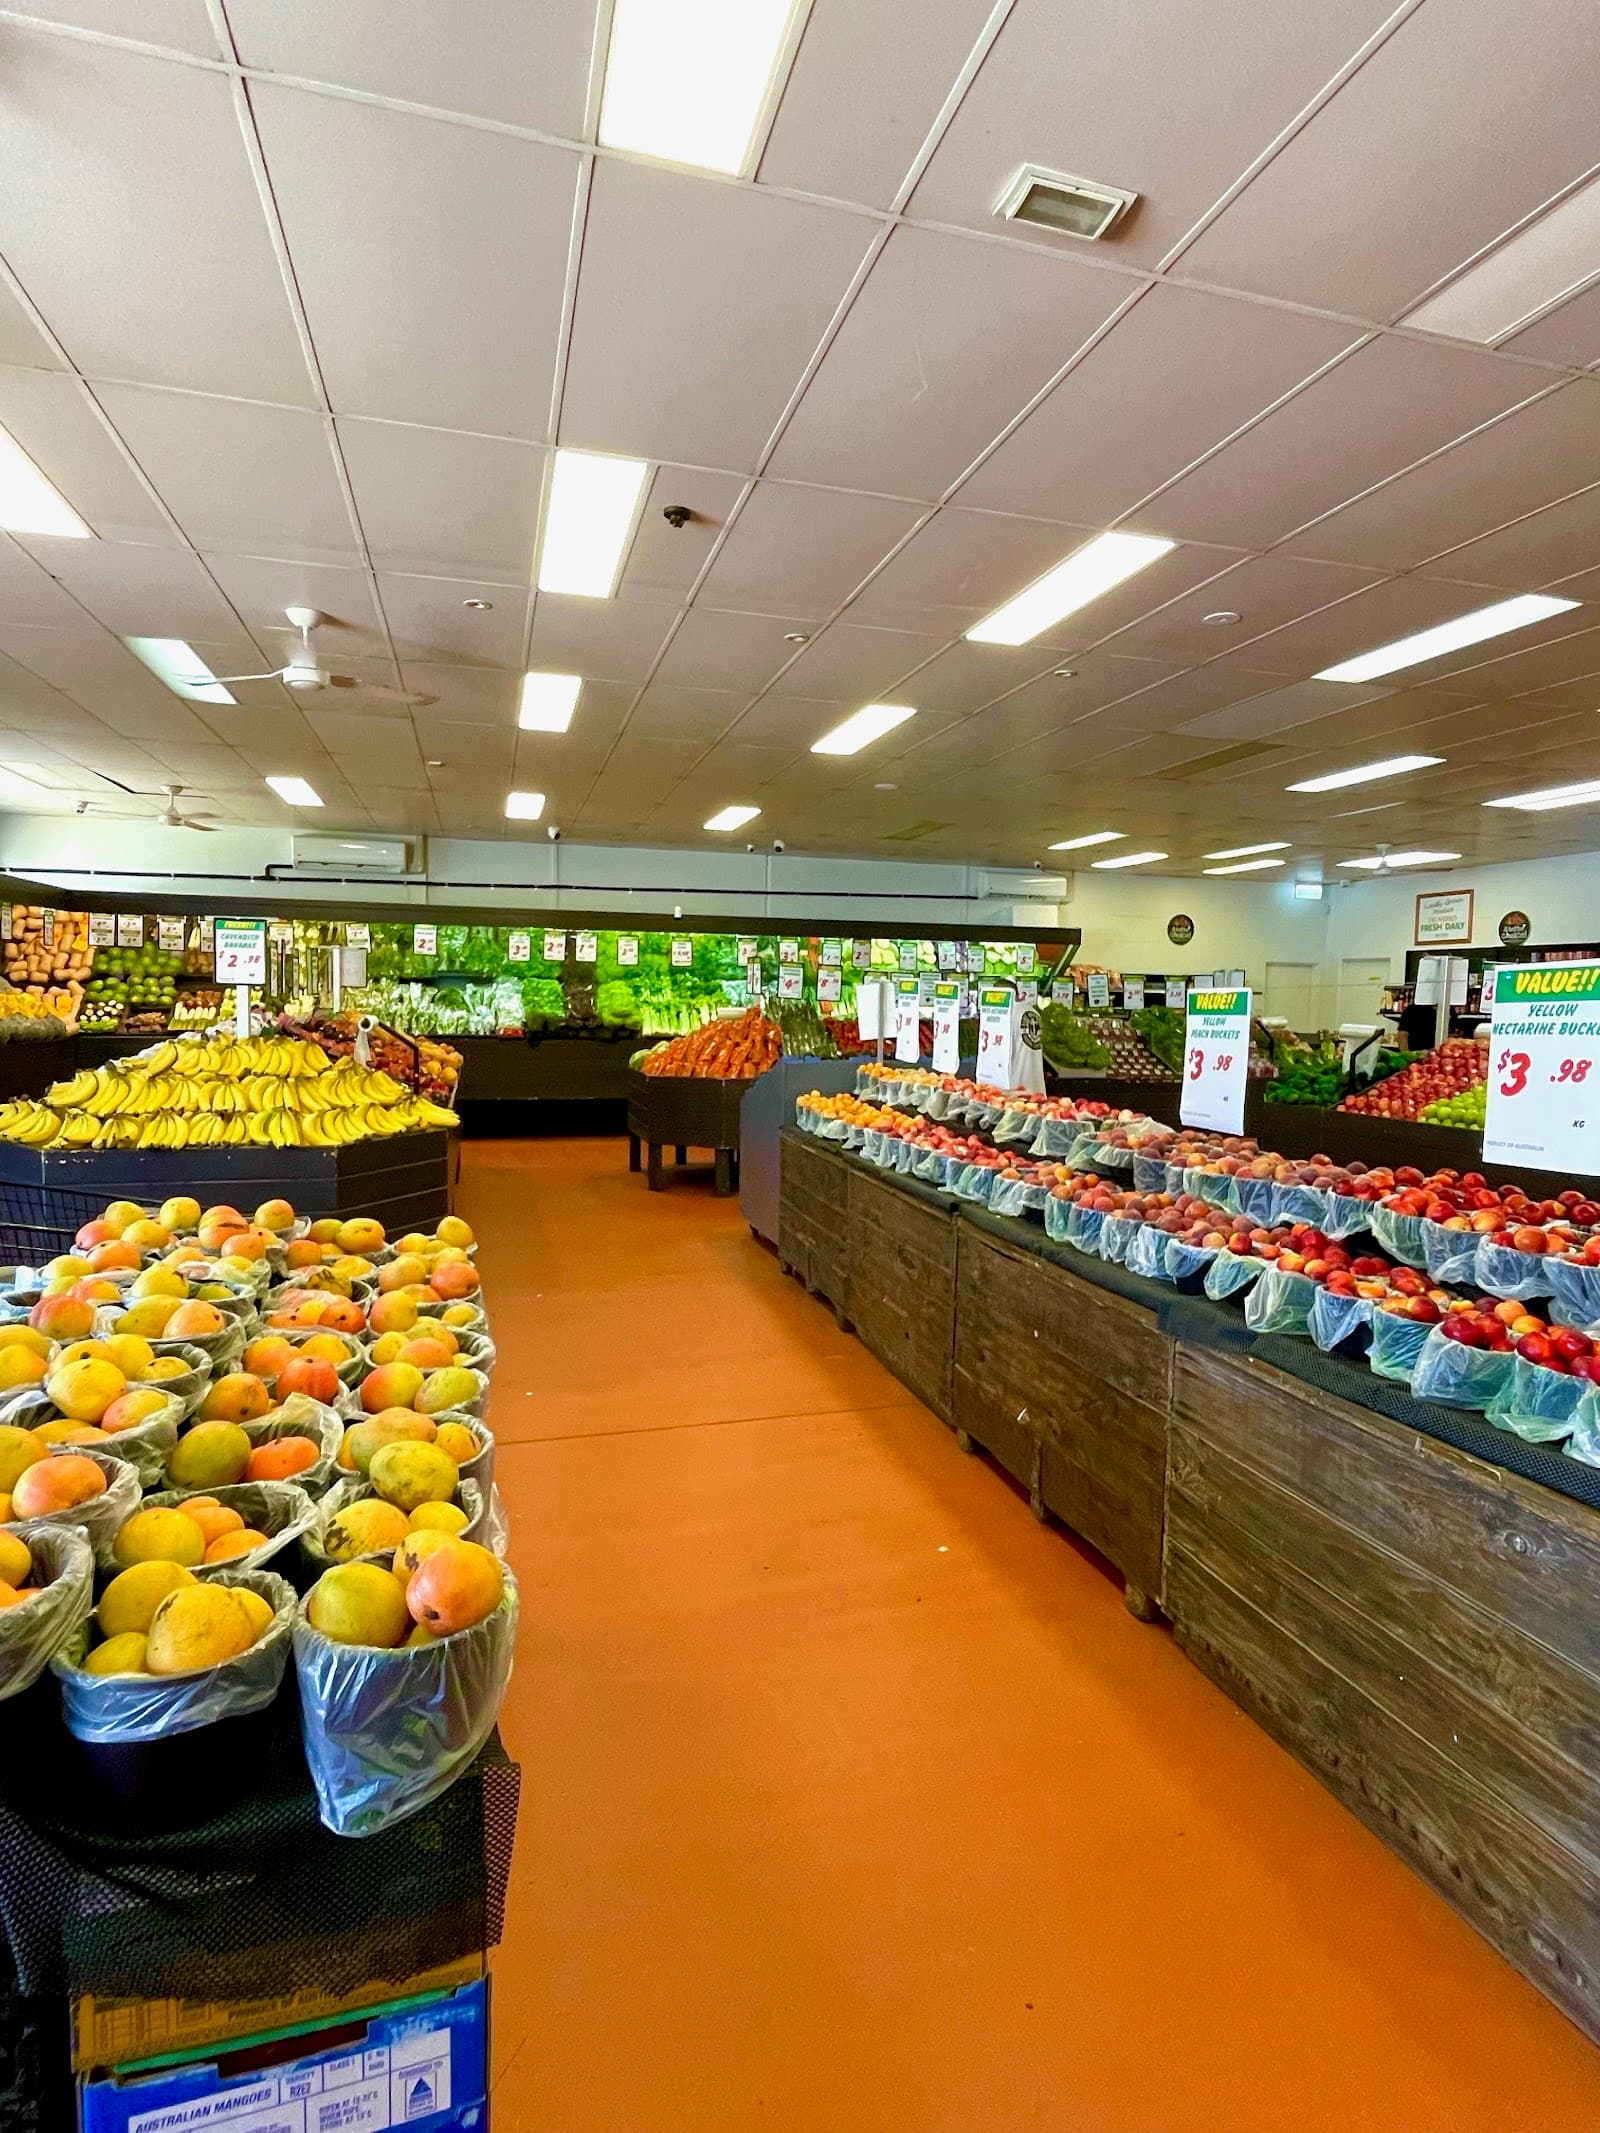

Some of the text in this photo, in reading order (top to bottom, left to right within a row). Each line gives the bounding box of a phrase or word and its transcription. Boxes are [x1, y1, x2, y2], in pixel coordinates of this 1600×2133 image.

[1421, 922, 1465, 932] FRESH DAILY
[1516, 968, 1600, 994] VALUE!!
[1195, 993, 1237, 1010] VALUE!!
[1528, 1003, 1579, 1017] YELLOW
[1202, 1017, 1227, 1026] YELLOW
[1492, 1022, 1556, 1035] NECTARINE
[1191, 1029, 1240, 1040] PEACH BUCKETS
[1213, 1055, 1232, 1071] .98
[1550, 1058, 1593, 1083] .98
[1572, 1120, 1586, 1128] KG
[290, 2083, 311, 2097] R2E2
[136, 2088, 272, 2133] AUSTRALIAN MANGOES
